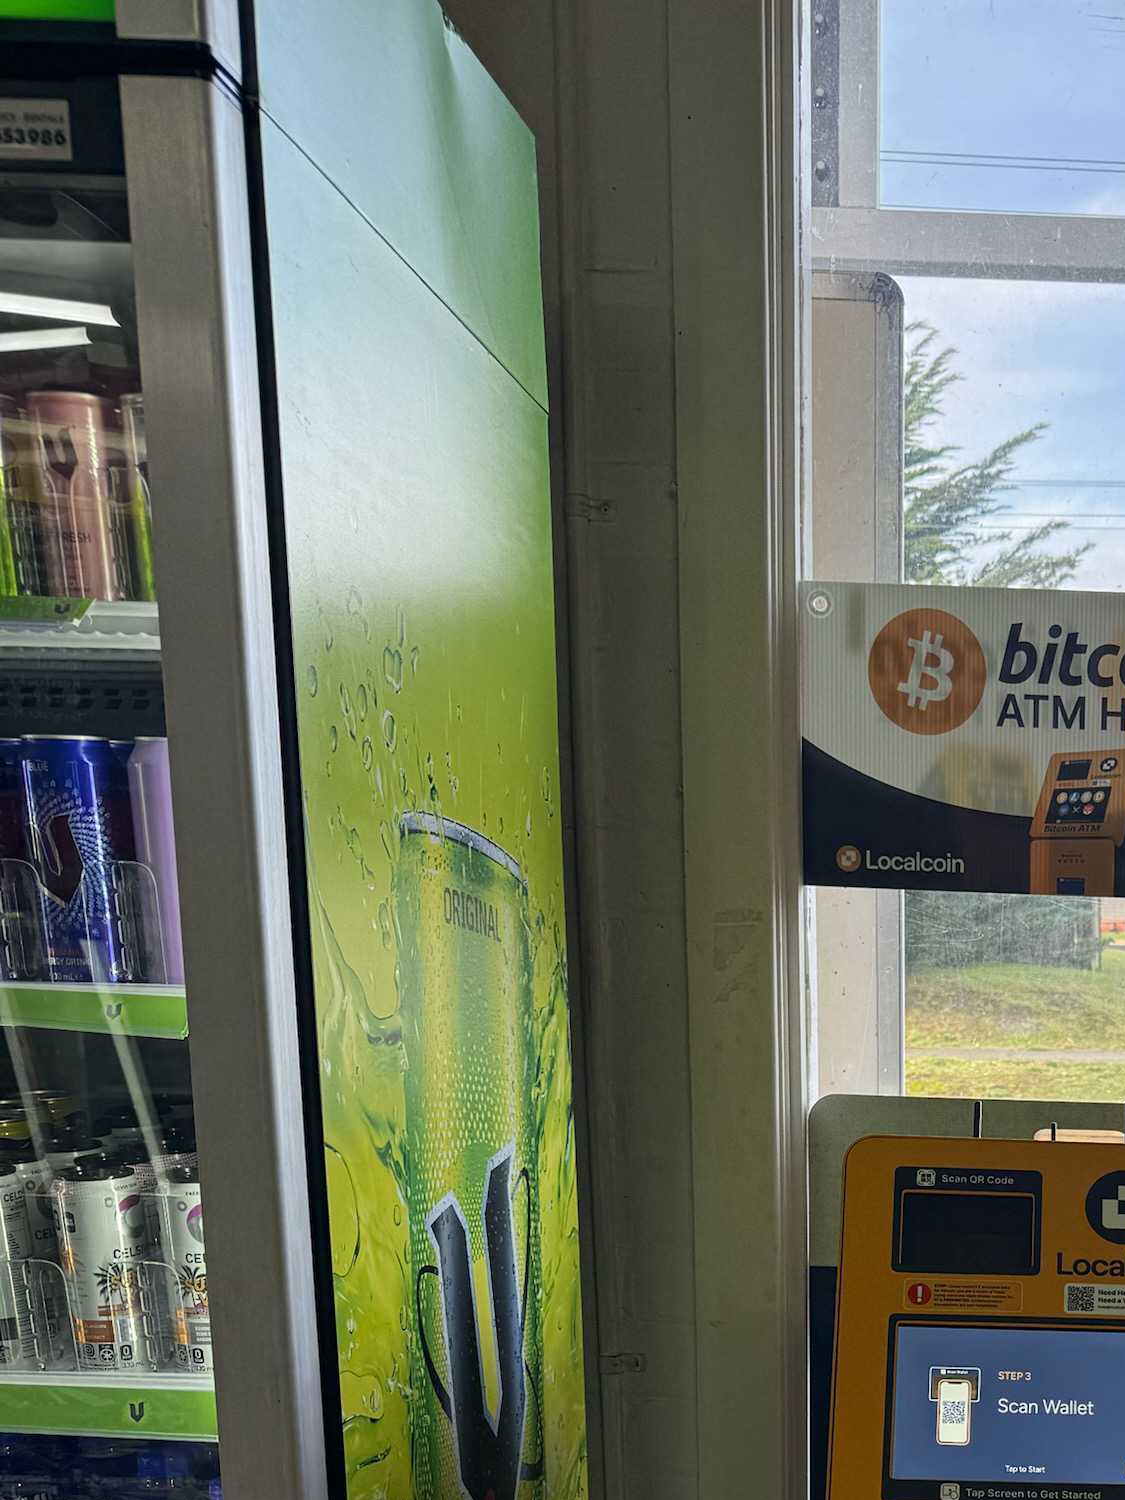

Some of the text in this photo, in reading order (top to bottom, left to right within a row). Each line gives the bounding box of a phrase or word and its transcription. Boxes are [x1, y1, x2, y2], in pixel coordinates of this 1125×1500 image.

[0, 128, 66, 146] 53986
[996, 694, 1086, 730] ATM
[866, 849, 966, 874] Localcoin
[443, 886, 502, 944] ORIGINAL
[941, 1173, 1014, 1186] Scan QR Code
[997, 1371, 1032, 1381] STEP 3
[997, 1398, 1094, 1416] Scan Wallet
[1005, 1464, 1046, 1475] Tap to Start
[965, 1487, 1101, 1500] Tap Screen to Get Started
